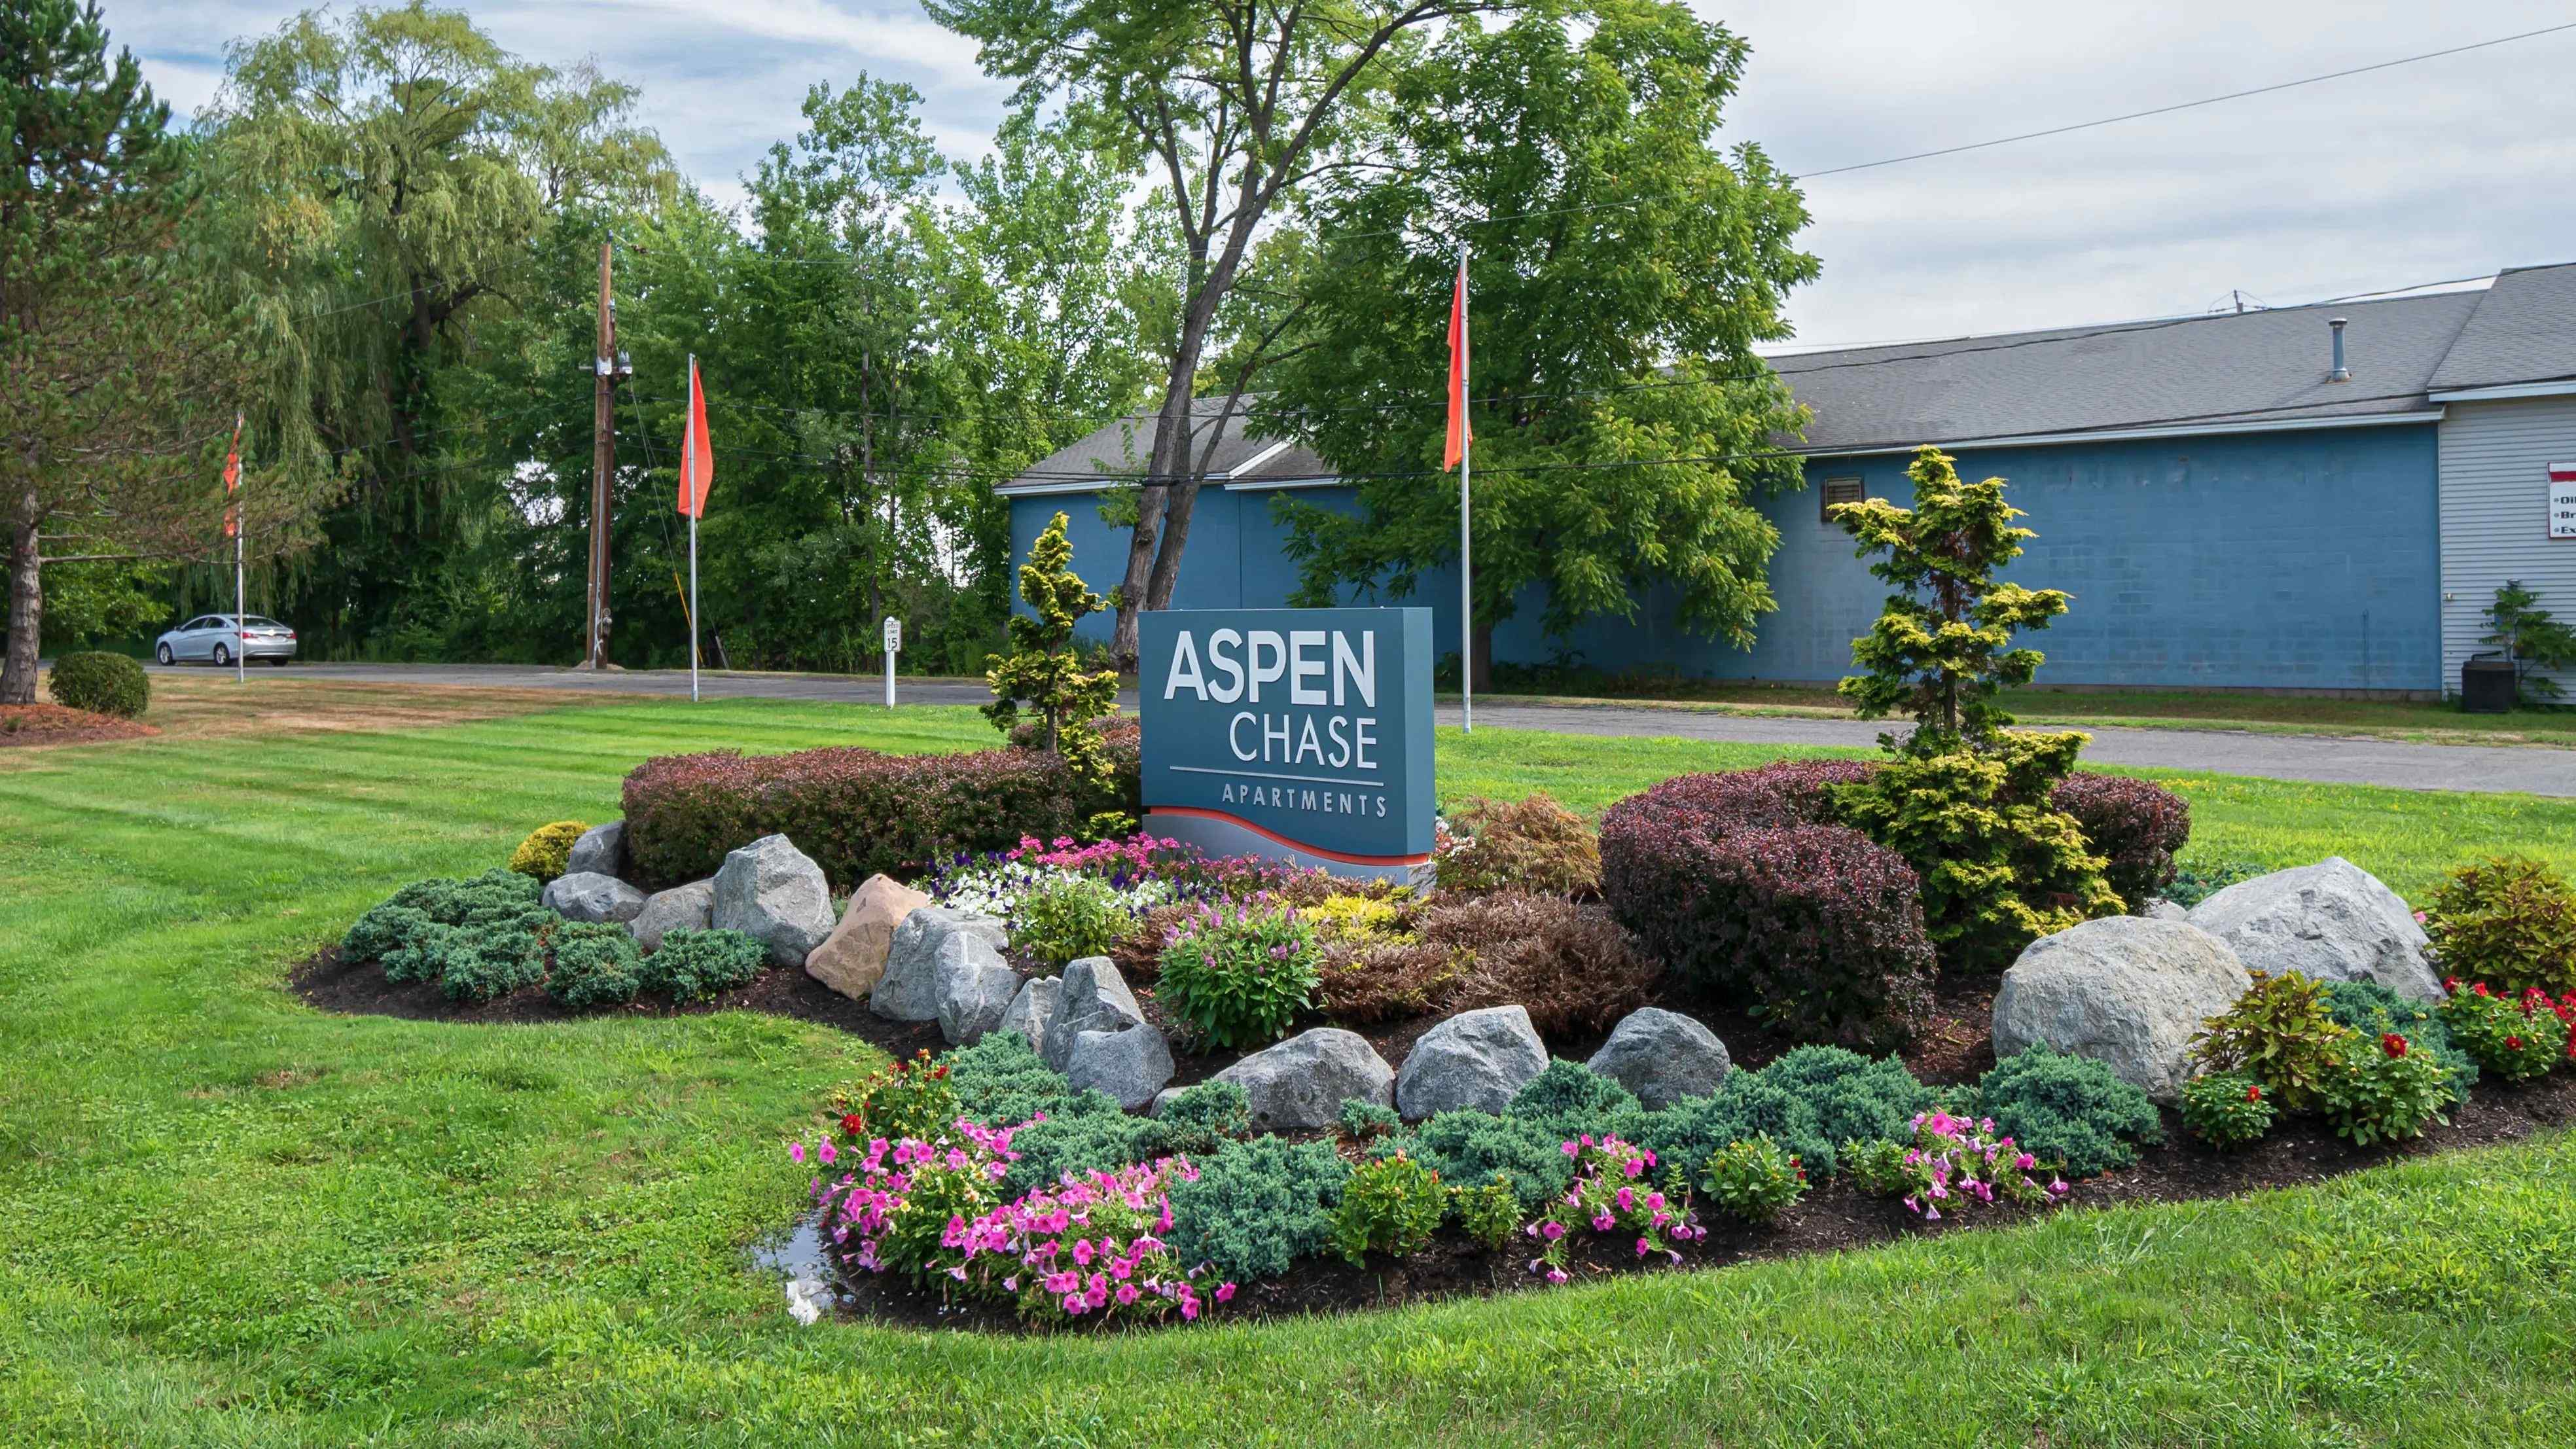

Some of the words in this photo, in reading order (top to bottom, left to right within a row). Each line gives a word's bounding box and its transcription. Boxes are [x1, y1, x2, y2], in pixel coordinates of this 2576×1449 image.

[887, 637, 897, 649] 15
[1164, 628, 1375, 707] ASPEN
[1229, 711, 1377, 769] CHASE
[1222, 783, 1387, 817] APARTMENTS
